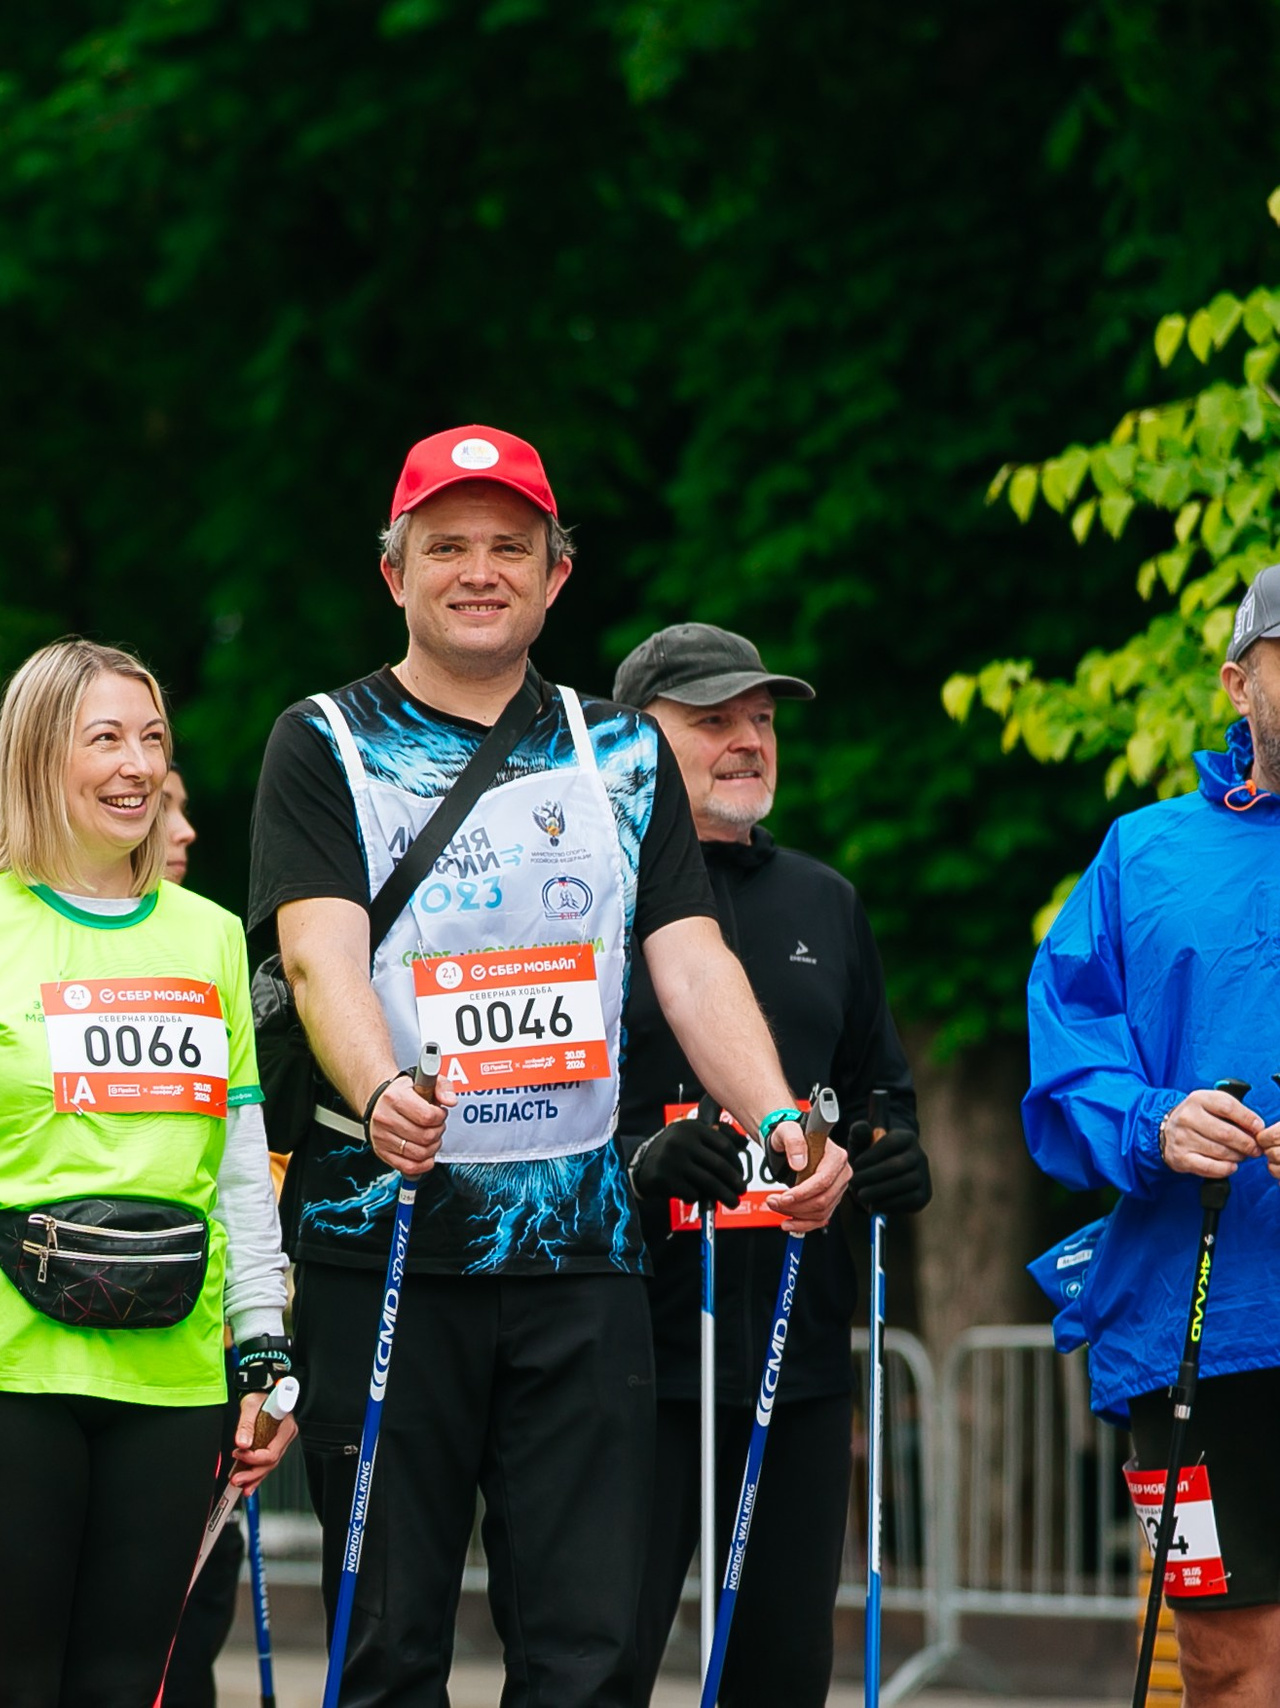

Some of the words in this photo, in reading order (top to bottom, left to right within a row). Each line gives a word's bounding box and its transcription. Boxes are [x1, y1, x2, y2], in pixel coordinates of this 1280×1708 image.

[409, 876, 503, 914] 023
[488, 963, 522, 976] СБЕР
[524, 957, 577, 973] МОБАЙЛ
[117, 990, 152, 1001] СБЕР
[153, 990, 205, 1004] МОБАЙЛ
[469, 989, 517, 1000] СЕВЕРНАЯ
[519, 986, 553, 996] ХОДЬБА
[148, 1016, 183, 1024] ХОДЬБА
[455, 995, 573, 1047] 0046
[84, 1025, 202, 1068] 0066
[566, 1060, 586, 1070] 2026
[463, 1099, 558, 1124] ОБЛАСТЬ
[392, 1219, 409, 1288] sport
[782, 1251, 800, 1317] sport
[346, 1522, 362, 1573] NORDIC
[354, 1460, 371, 1521] WALKING
[728, 1541, 745, 1591] NORDIC
[737, 1483, 755, 1541] WALKING
